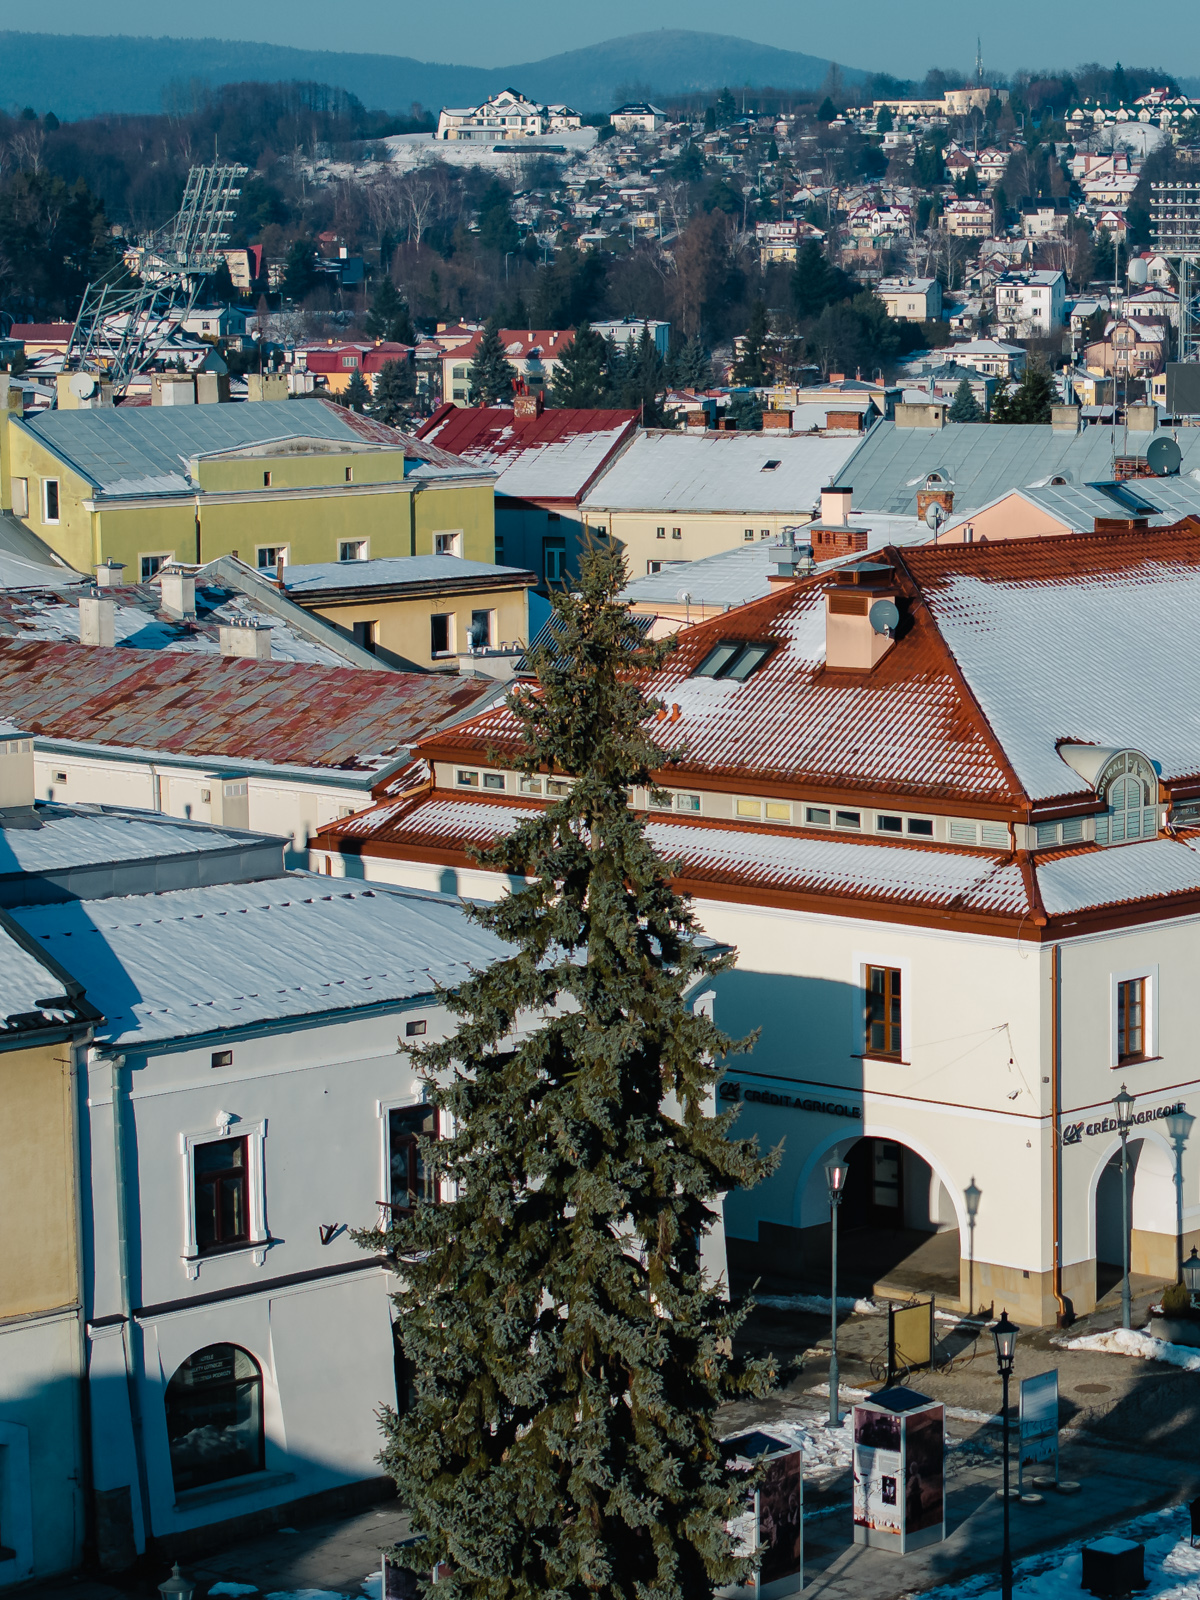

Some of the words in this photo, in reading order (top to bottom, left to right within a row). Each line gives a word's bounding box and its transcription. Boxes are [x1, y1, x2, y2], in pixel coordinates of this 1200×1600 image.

[1098, 760, 1124, 800] DMIRAL
[744, 1089, 791, 1108] CRÉDIT
[793, 1098, 861, 1118] AGRICOLE
[1130, 1103, 1185, 1125] AGRICOLE
